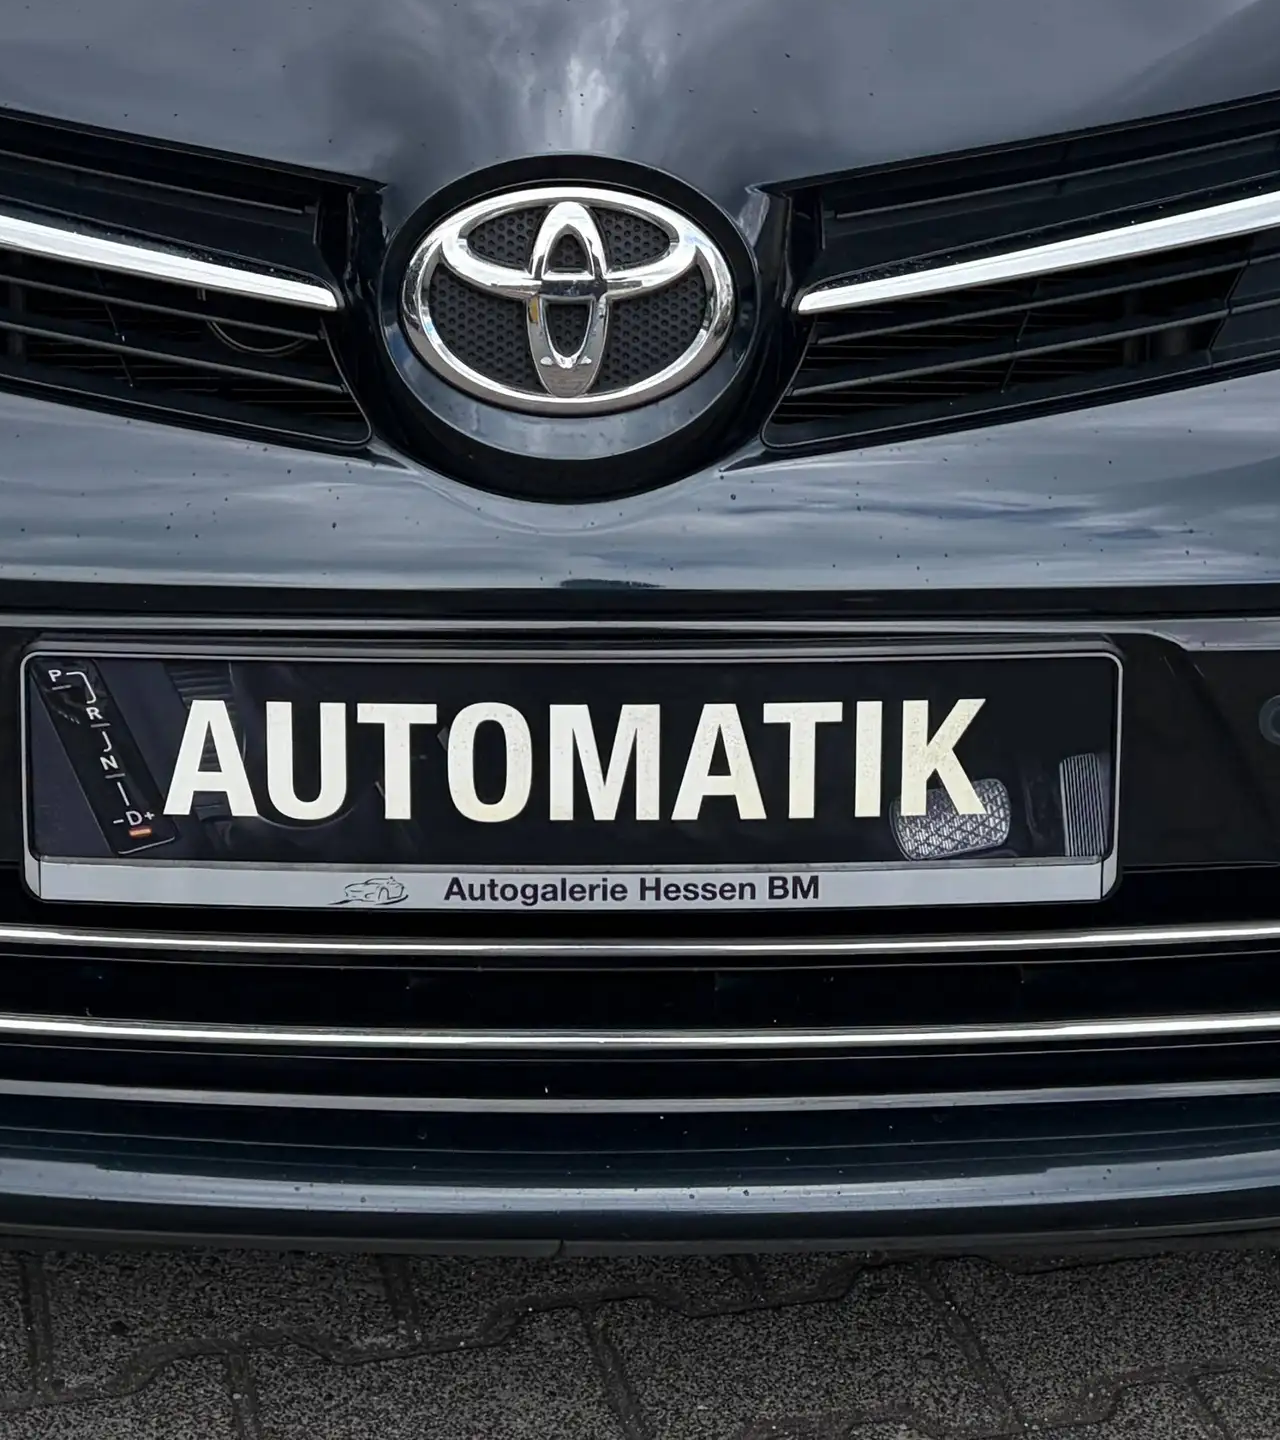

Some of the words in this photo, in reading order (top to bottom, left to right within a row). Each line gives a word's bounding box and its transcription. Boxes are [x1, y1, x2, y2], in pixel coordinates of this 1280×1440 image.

[163, 698, 987, 823] AUTOMATIK
[443, 876, 629, 906] Autogalerie
[639, 877, 757, 902] Hessen
[766, 875, 820, 901] BM
